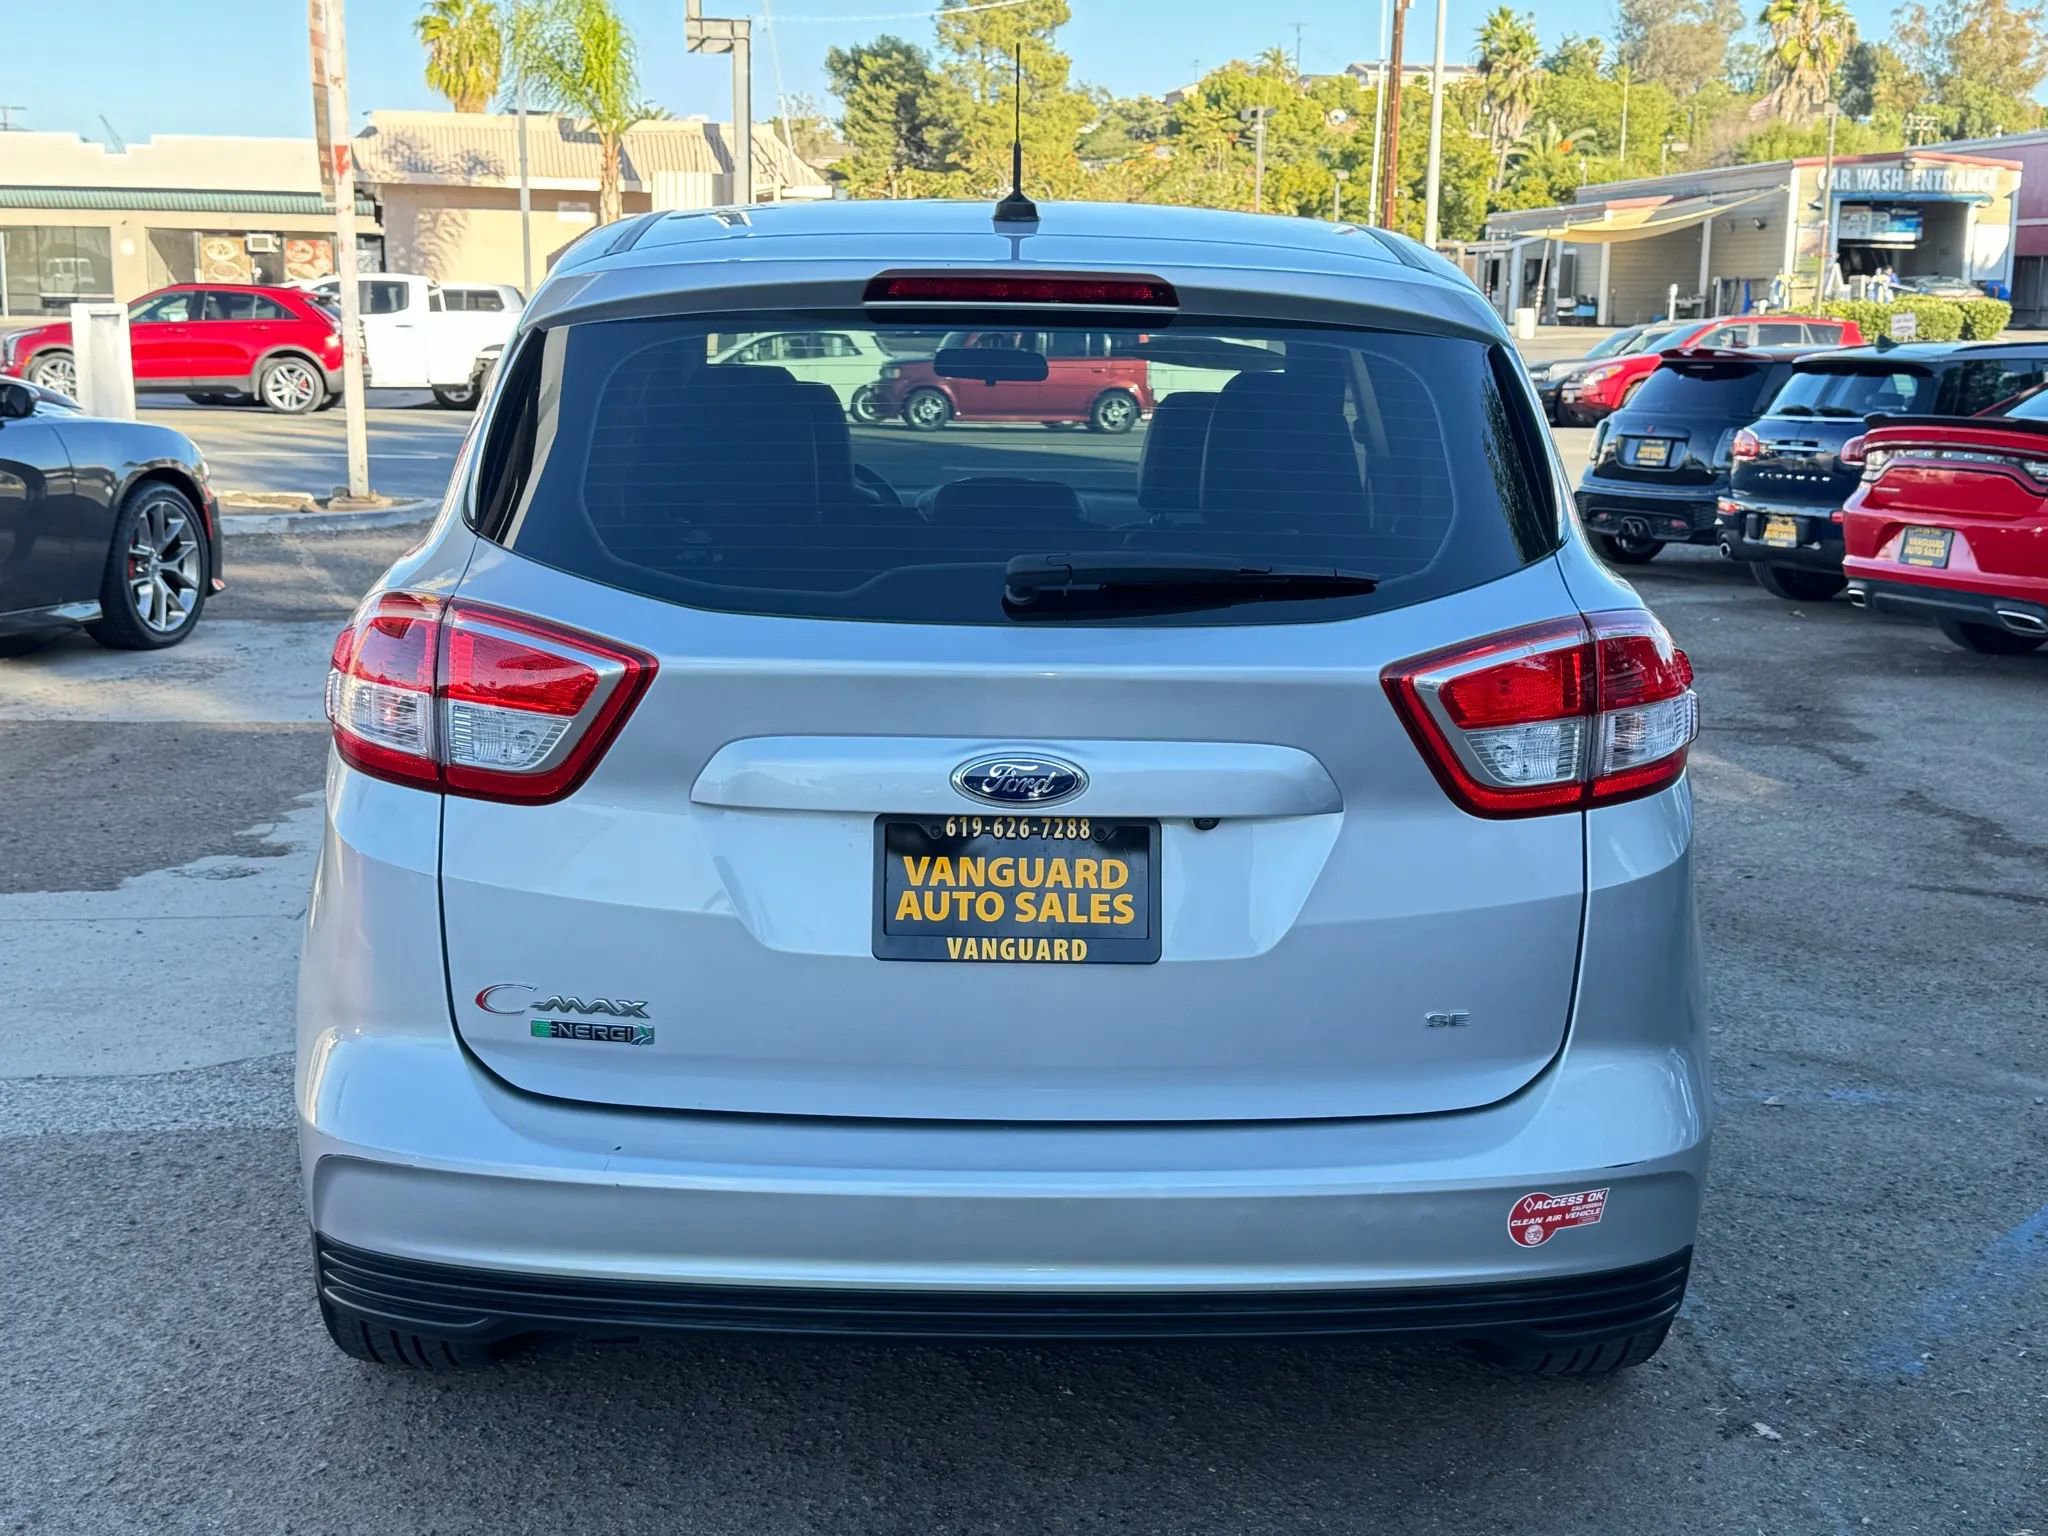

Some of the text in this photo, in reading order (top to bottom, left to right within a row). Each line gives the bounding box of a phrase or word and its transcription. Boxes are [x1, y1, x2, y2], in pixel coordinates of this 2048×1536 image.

[1857, 168, 1904, 191] WASH
[981, 763, 1055, 795] Ford
[945, 815, 1091, 839] 619-626-7288
[903, 855, 1129, 890] VANGUARD
[895, 890, 1136, 925] AUTO SALES
[946, 937, 1088, 962] VANGUARD
[1424, 1011, 1471, 1028] SE
[532, 1020, 634, 1043] ENERGI
[1534, 1191, 1605, 1210] ACCESS OK
[1511, 1216, 1543, 1227] CLEAN
[1545, 1213, 1563, 1223] AIR
[1565, 1208, 1601, 1219] VEHICLE
